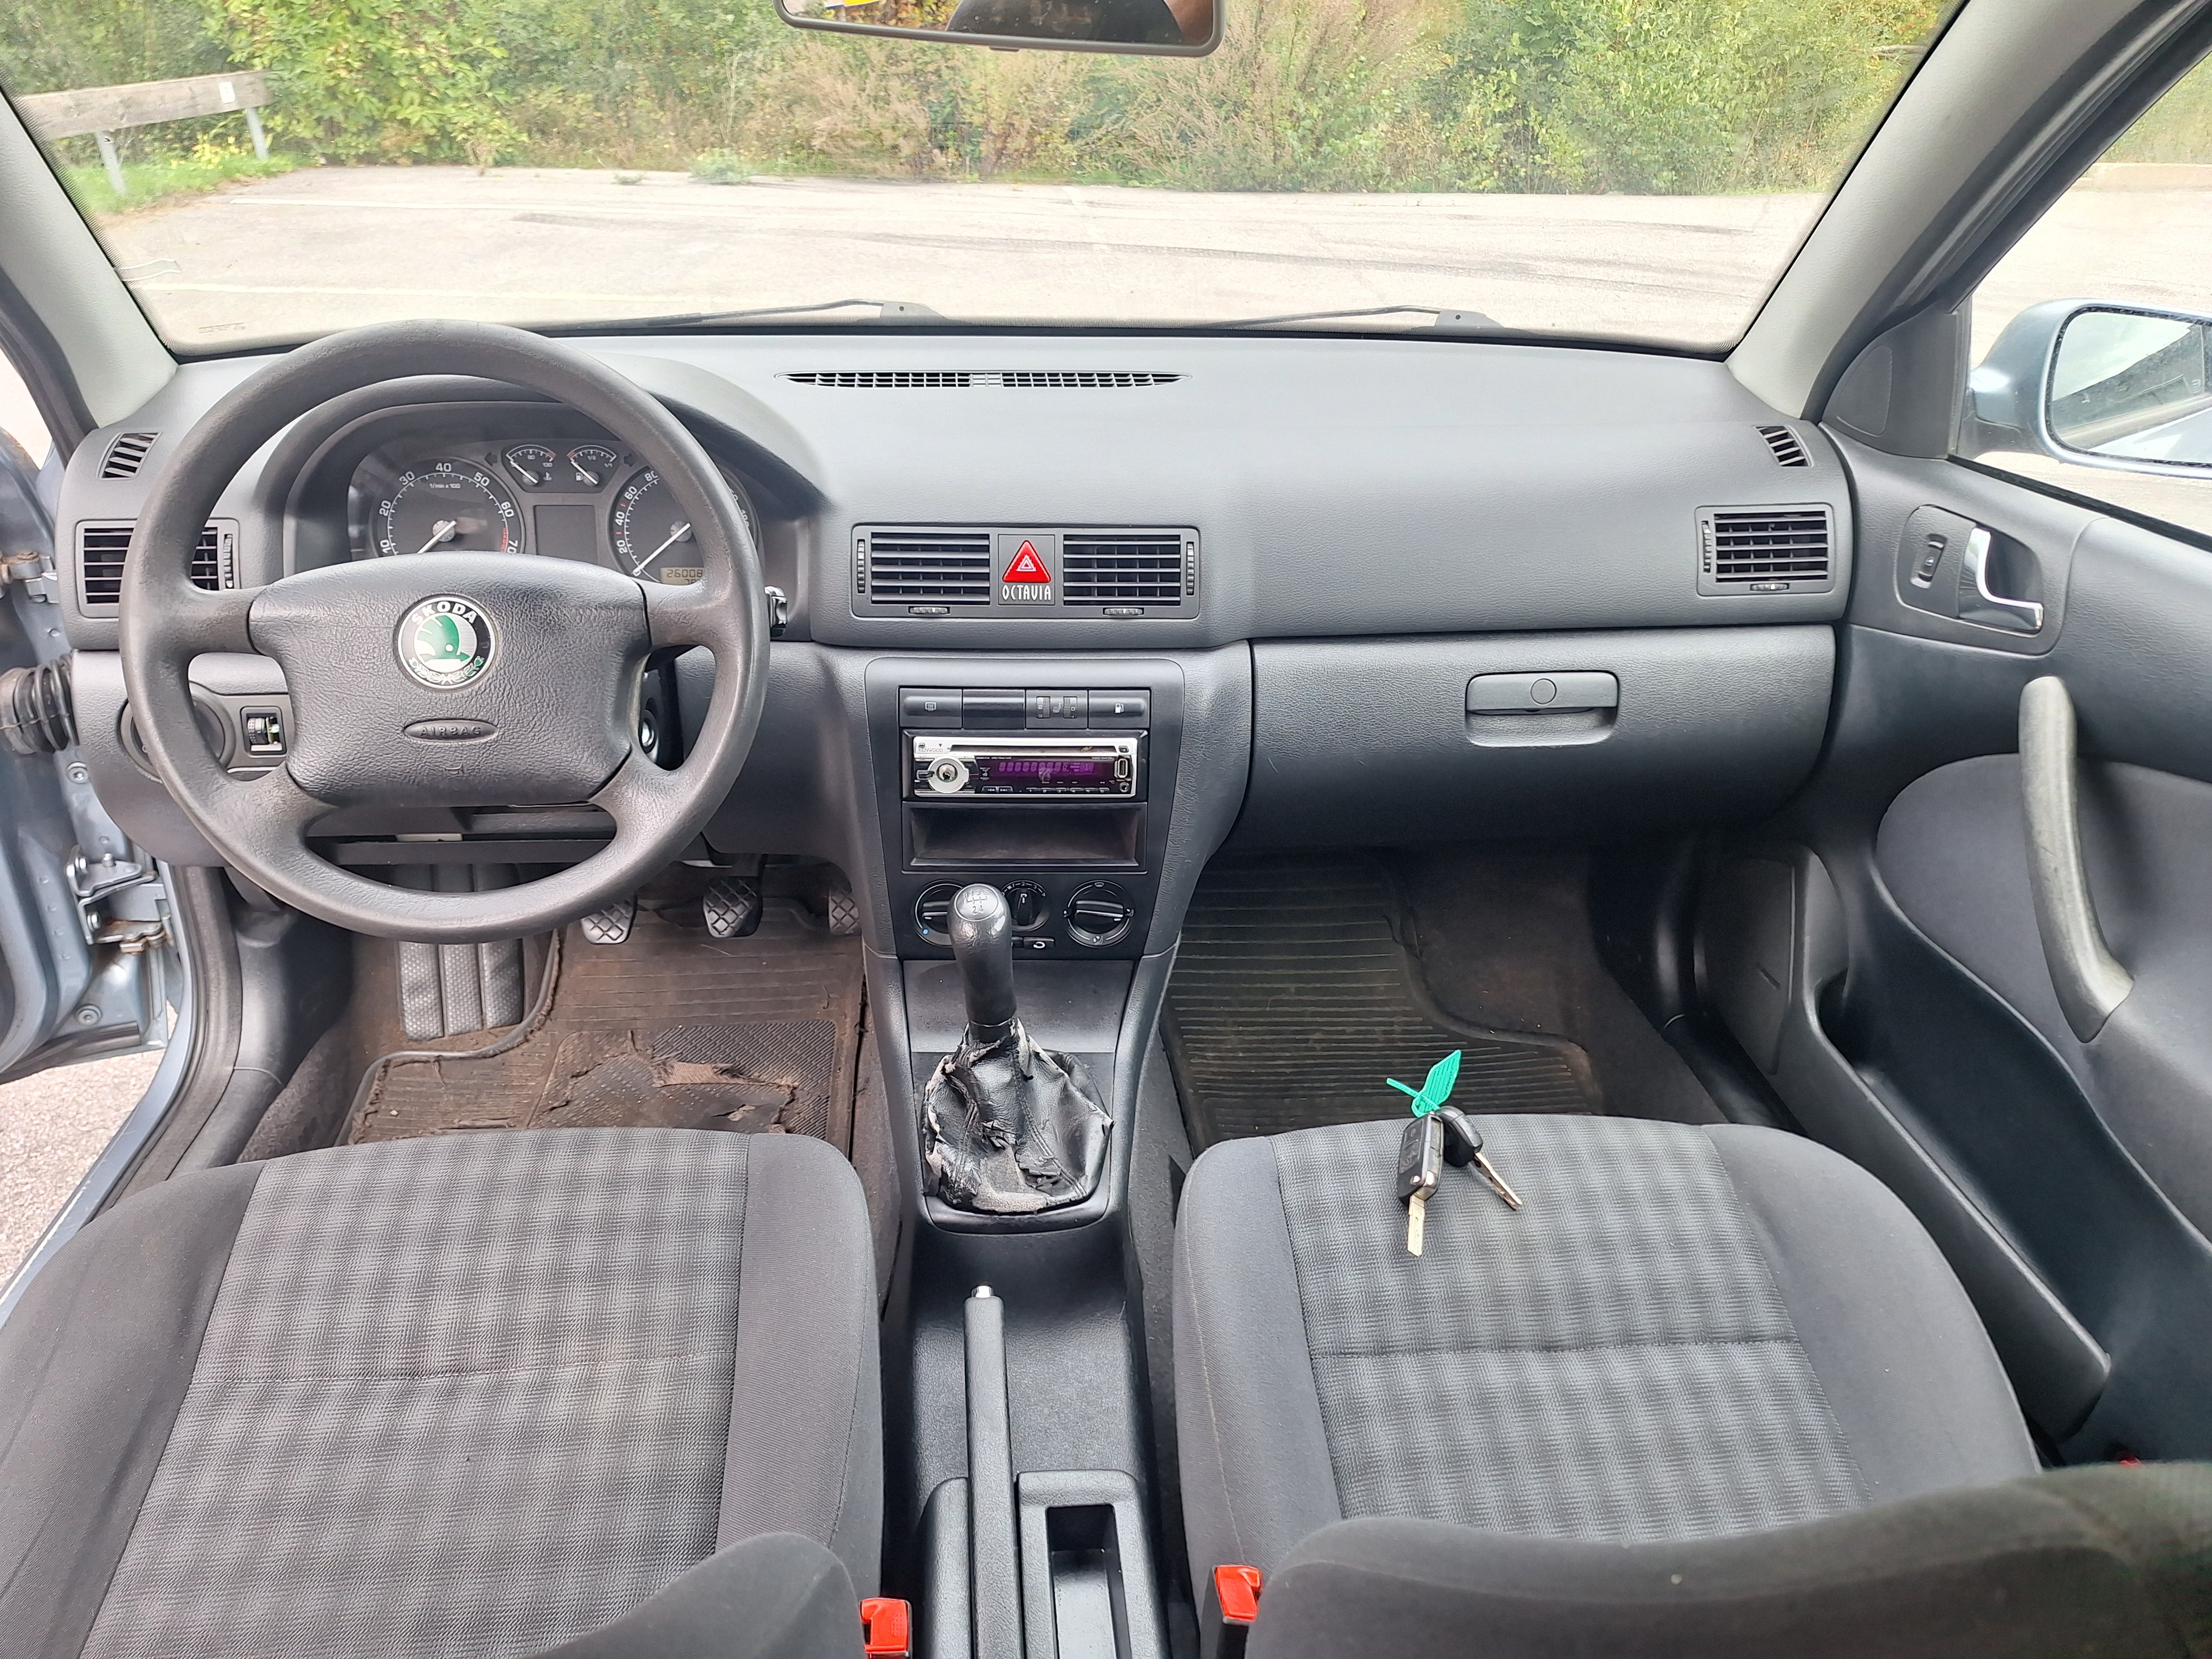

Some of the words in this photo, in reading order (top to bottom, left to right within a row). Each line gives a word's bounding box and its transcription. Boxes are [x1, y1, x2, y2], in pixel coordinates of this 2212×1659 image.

[435, 462, 452, 472] 40
[398, 471, 416, 486] 30
[473, 471, 490, 486] 50
[625, 486, 638, 500] 60
[378, 500, 391, 517] 20
[501, 501, 515, 518] 60
[615, 511, 625, 526] 40
[380, 539, 391, 554] 10
[506, 539, 519, 554] 70
[616, 539, 627, 554] 20
[666, 569, 703, 578] 26008
[1002, 584, 1051, 601] OCTAVIA
[420, 726, 482, 737] AIRBAG
[972, 905, 978, 915] 2
[979, 905, 984, 914] 4
